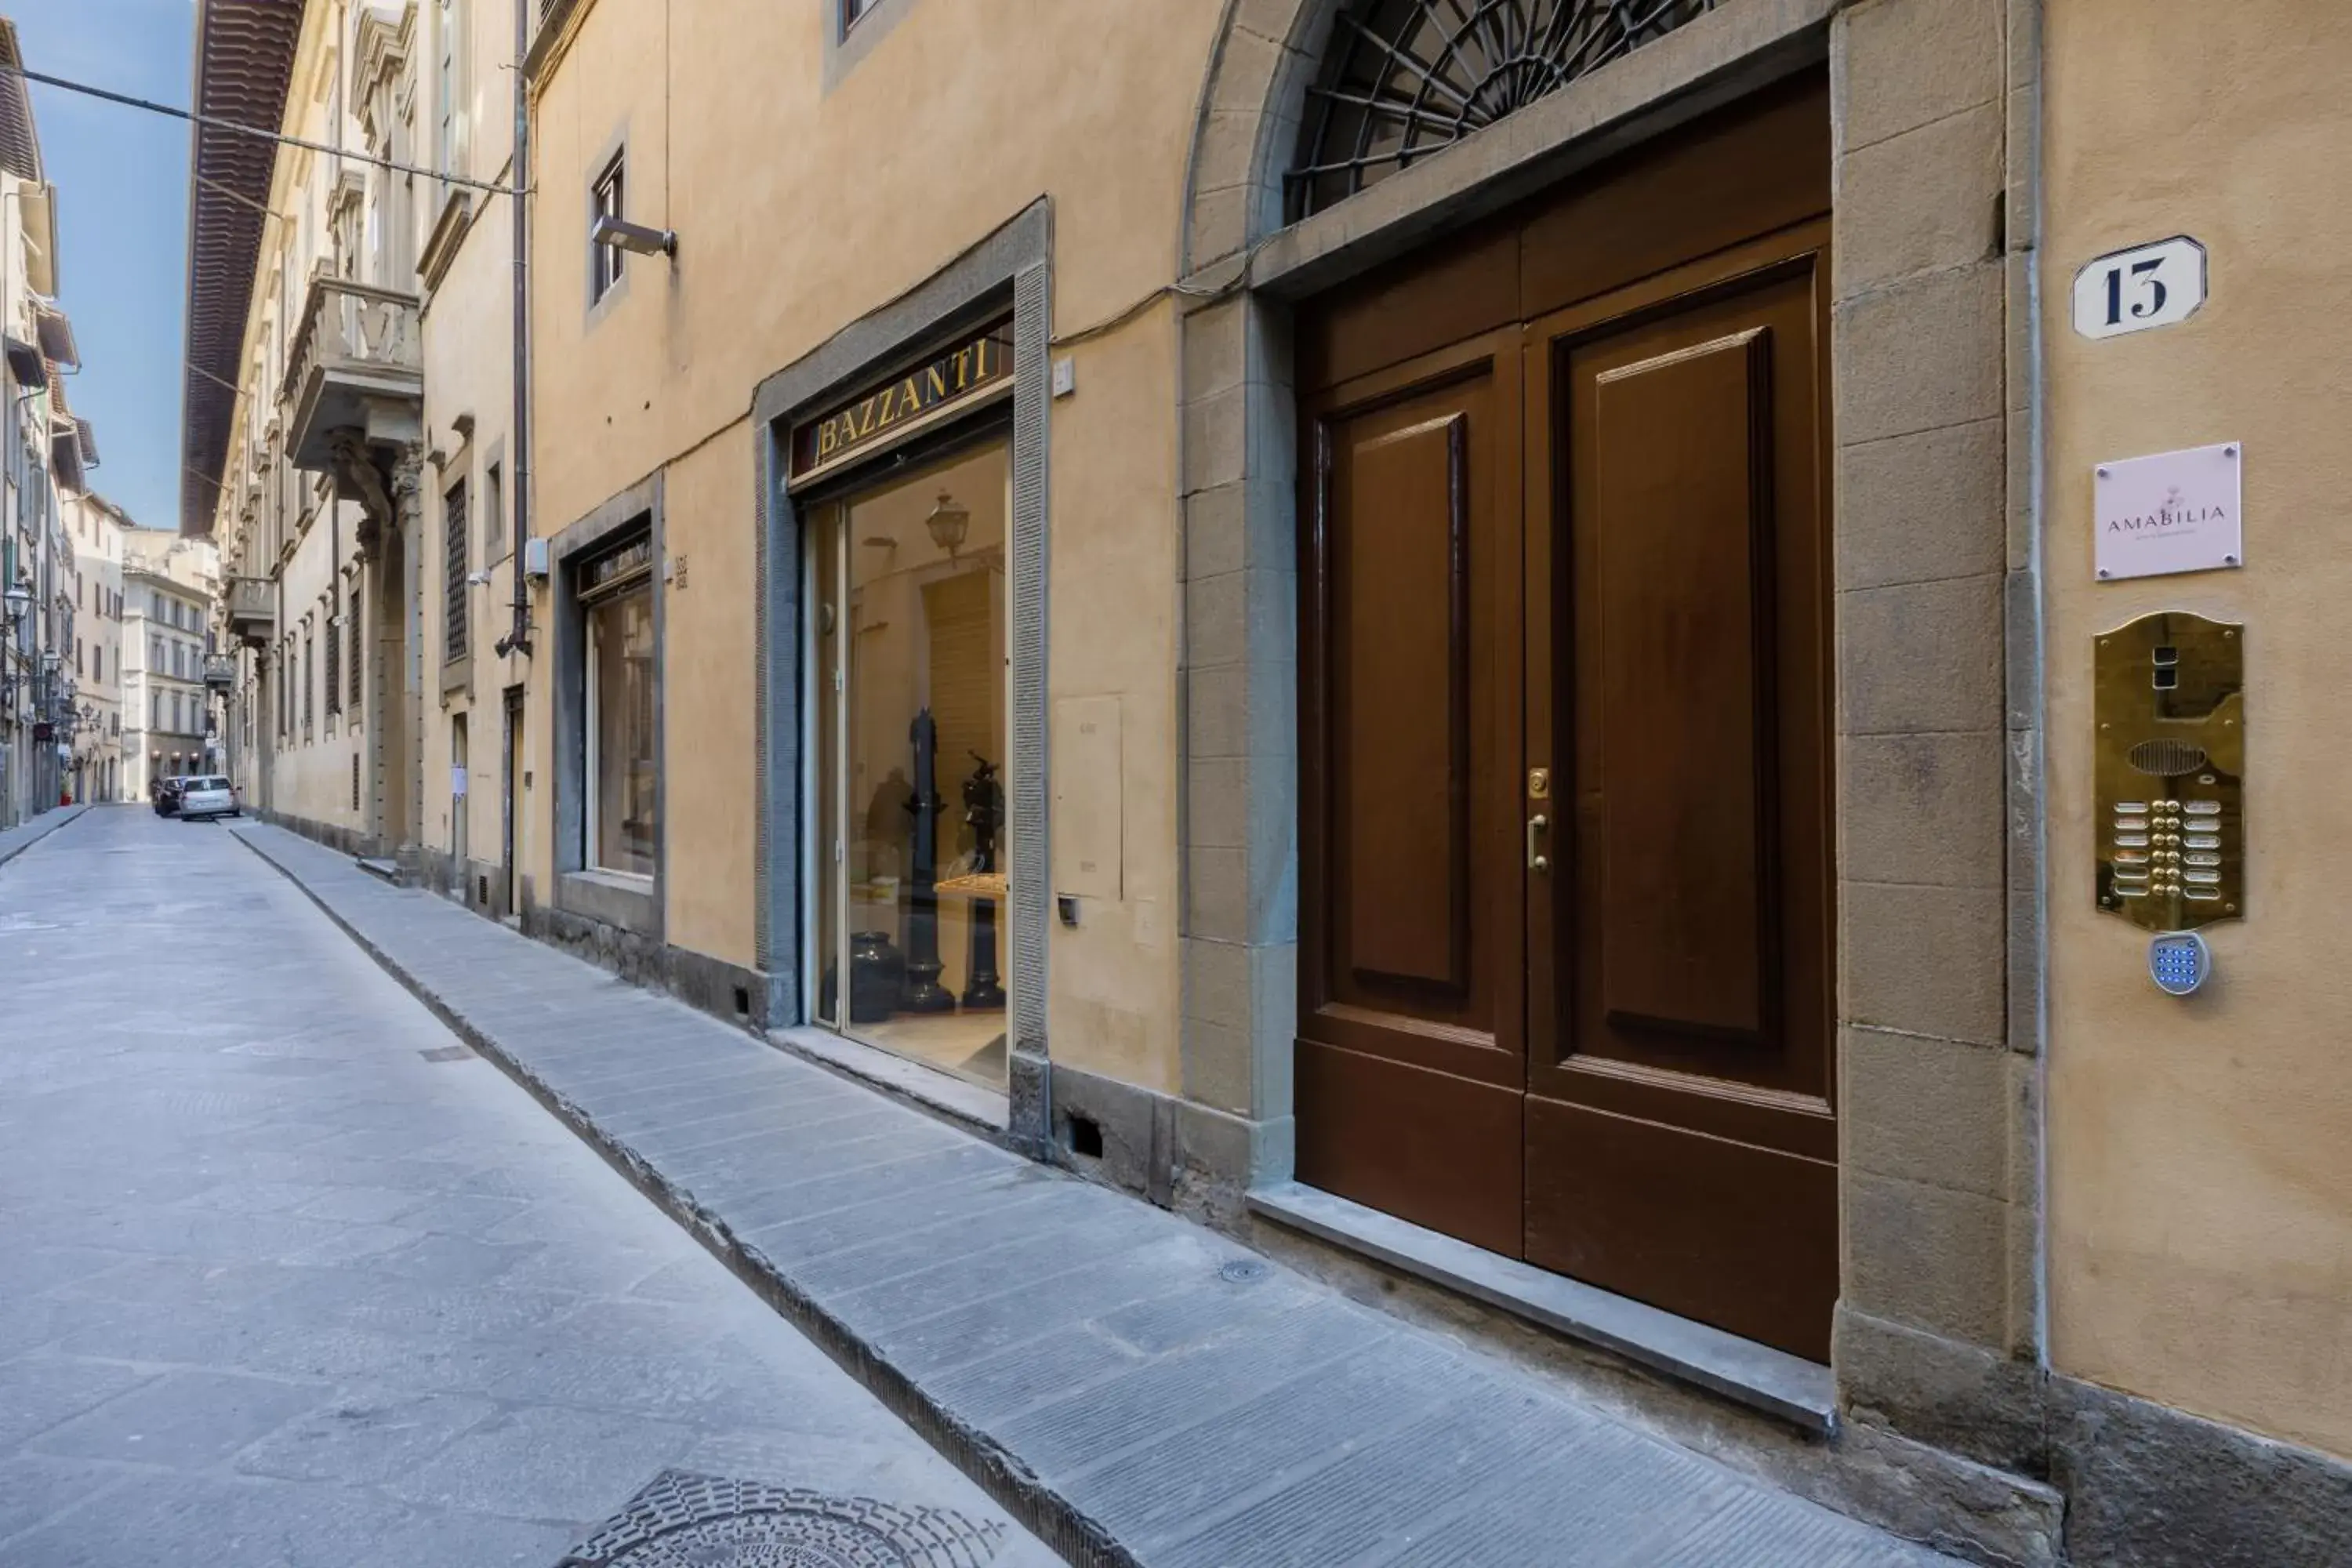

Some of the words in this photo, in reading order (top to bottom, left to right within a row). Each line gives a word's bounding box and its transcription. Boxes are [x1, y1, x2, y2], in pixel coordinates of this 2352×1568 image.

[2101, 256, 2166, 325] 13
[817, 337, 986, 458] BAZZANTI
[2108, 506, 2225, 532] AMABILIA
